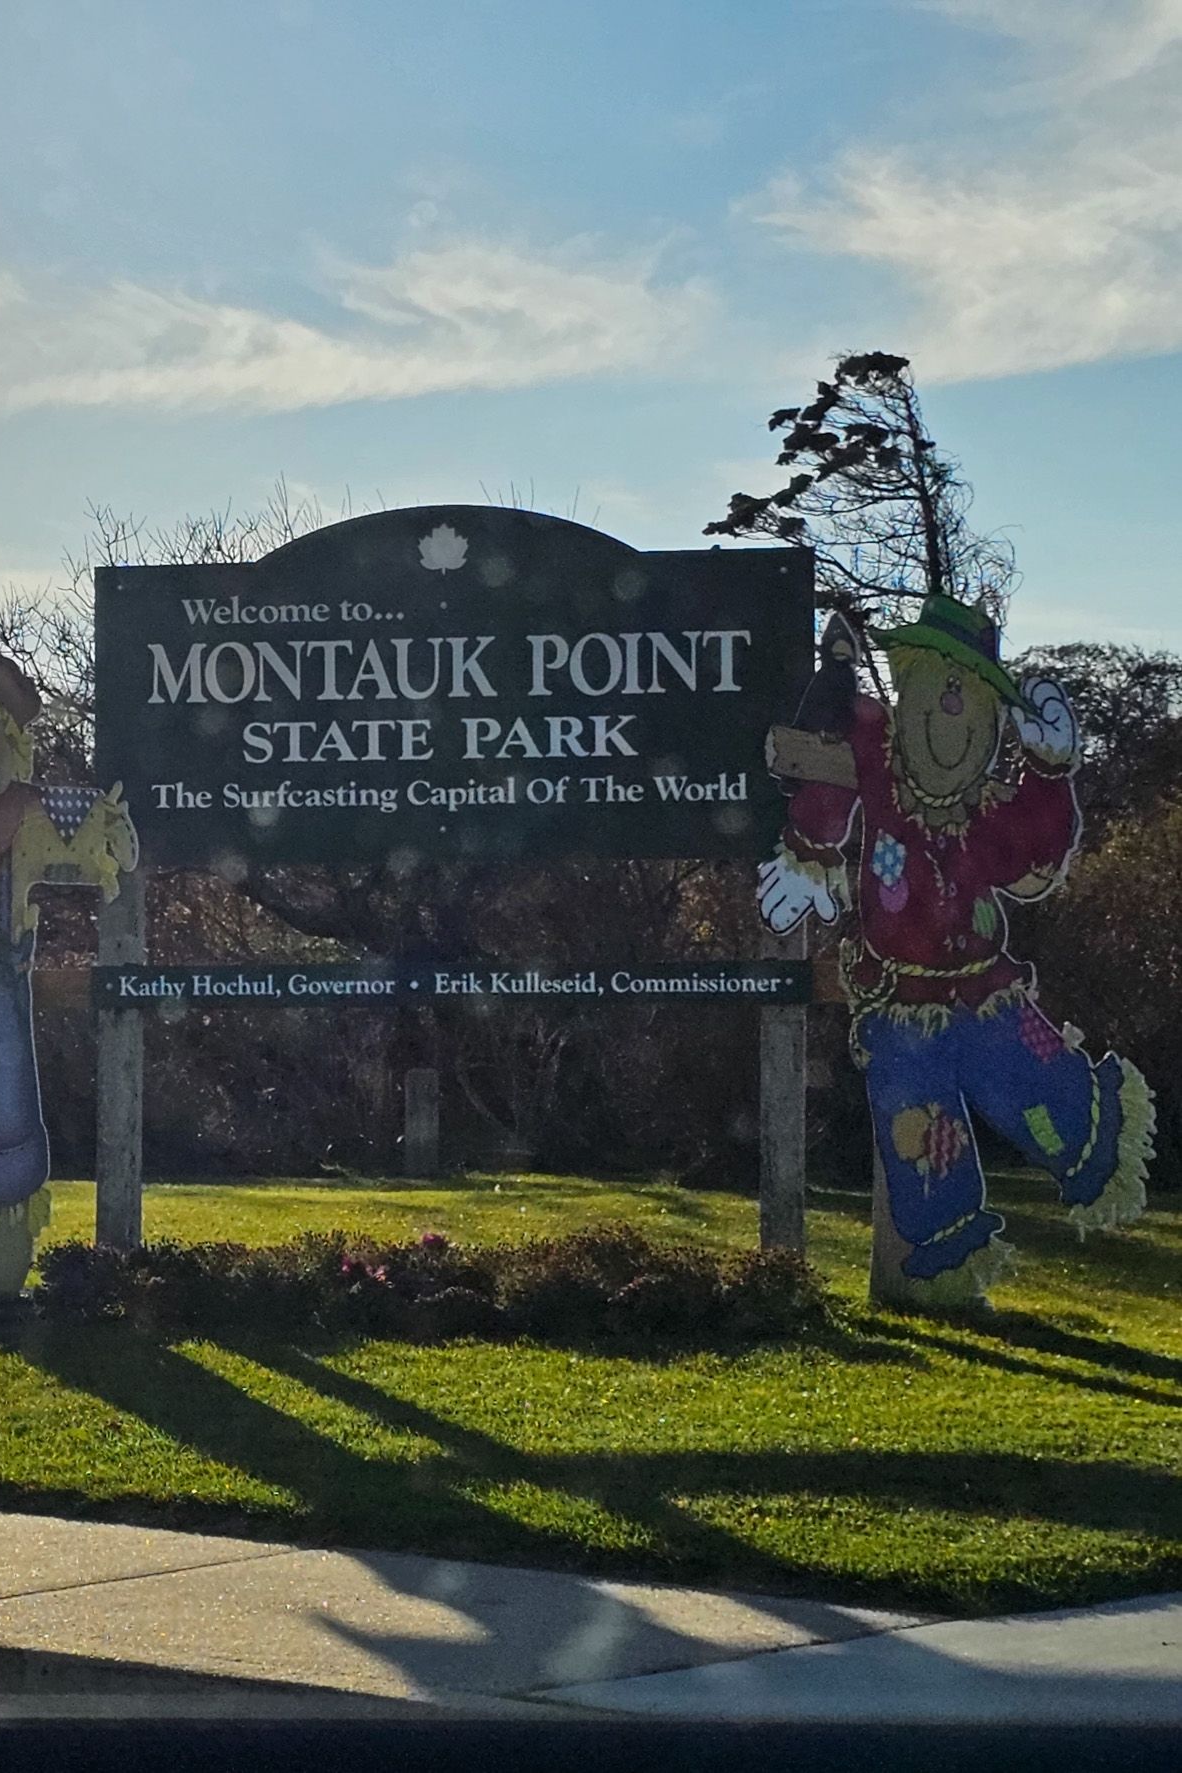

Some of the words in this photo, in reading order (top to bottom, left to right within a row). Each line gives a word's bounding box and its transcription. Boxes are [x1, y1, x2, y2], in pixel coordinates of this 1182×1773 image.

[182, 597, 330, 625] Welcome
[340, 599, 405, 622] to...
[147, 635, 498, 705] MONTAUK
[526, 629, 752, 697] POINT
[242, 718, 434, 765] STATE
[461, 714, 639, 761] PARK
[151, 782, 213, 810] The
[222, 779, 398, 813] Surfcasting
[406, 777, 517, 812] Capital
[526, 775, 571, 805] Of
[580, 776, 645, 804] The
[654, 773, 748, 802] World
[118, 975, 186, 999] Kathy
[192, 974, 281, 998] Hochul,
[287, 973, 396, 996] Governor
[434, 972, 484, 994] Erik
[489, 971, 605, 997] Kulleseid,
[610, 971, 781, 994] Commissioner
